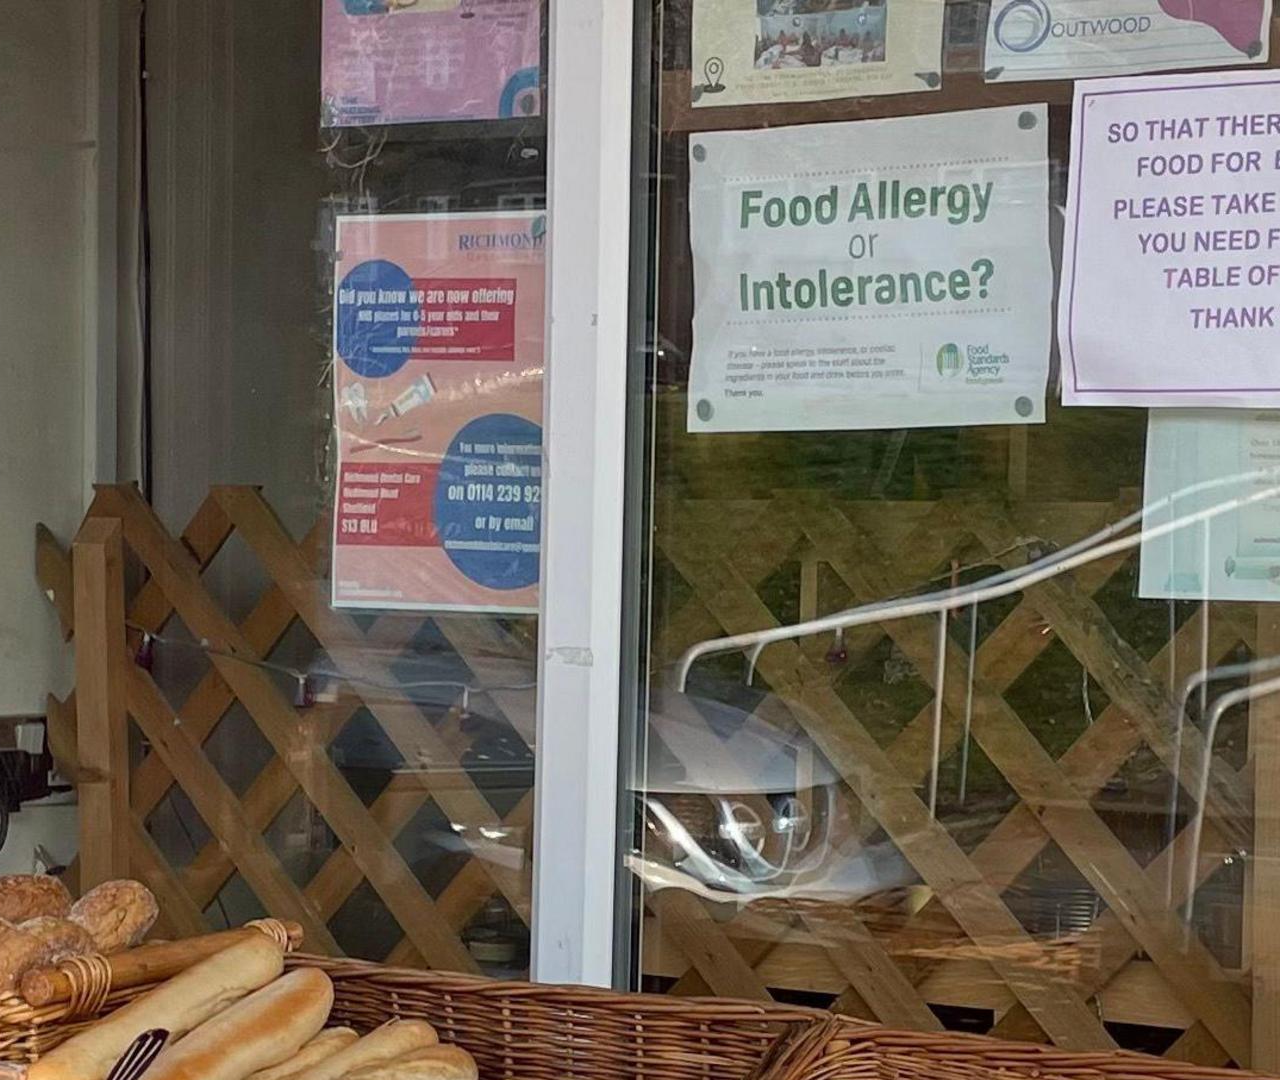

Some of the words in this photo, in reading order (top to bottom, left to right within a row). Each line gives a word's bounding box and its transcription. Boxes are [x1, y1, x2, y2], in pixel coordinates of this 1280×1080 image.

[1051, 16, 1151, 37] OUTWOOD
[1107, 122, 1139, 143] SO
[1145, 117, 1209, 141] THAT
[1137, 154, 1203, 177] FOOD
[1211, 150, 1261, 173] FOR
[740, 185, 838, 229] Food
[847, 180, 993, 225] Allergy
[1113, 195, 1204, 219] PLEASE
[1211, 192, 1276, 215] TAKE
[848, 233, 878, 259] or
[1137, 232, 1186, 254] YOU
[1194, 228, 1260, 252] NEED
[739, 258, 995, 311] Intolerance?
[1163, 267, 1241, 289] TABLE
[1248, 265, 1280, 286] OF
[339, 289, 355, 304] Did
[356, 291, 376, 306] you
[378, 289, 406, 304] know
[409, 291, 424, 304] we
[427, 291, 444, 303] are
[447, 291, 469, 304] now
[472, 288, 514, 305] offering
[1190, 306, 1275, 329] THANK
[968, 344, 988, 356] Food
[968, 352, 1009, 364] Standards
[967, 362, 1000, 377] Agency
[448, 485, 464, 501] on
[467, 483, 494, 502] 0114
[497, 485, 521, 503] 239
[342, 518, 358, 533] S13
[475, 516, 486, 529] or
[489, 515, 502, 532] by
[504, 516, 534, 531] email
